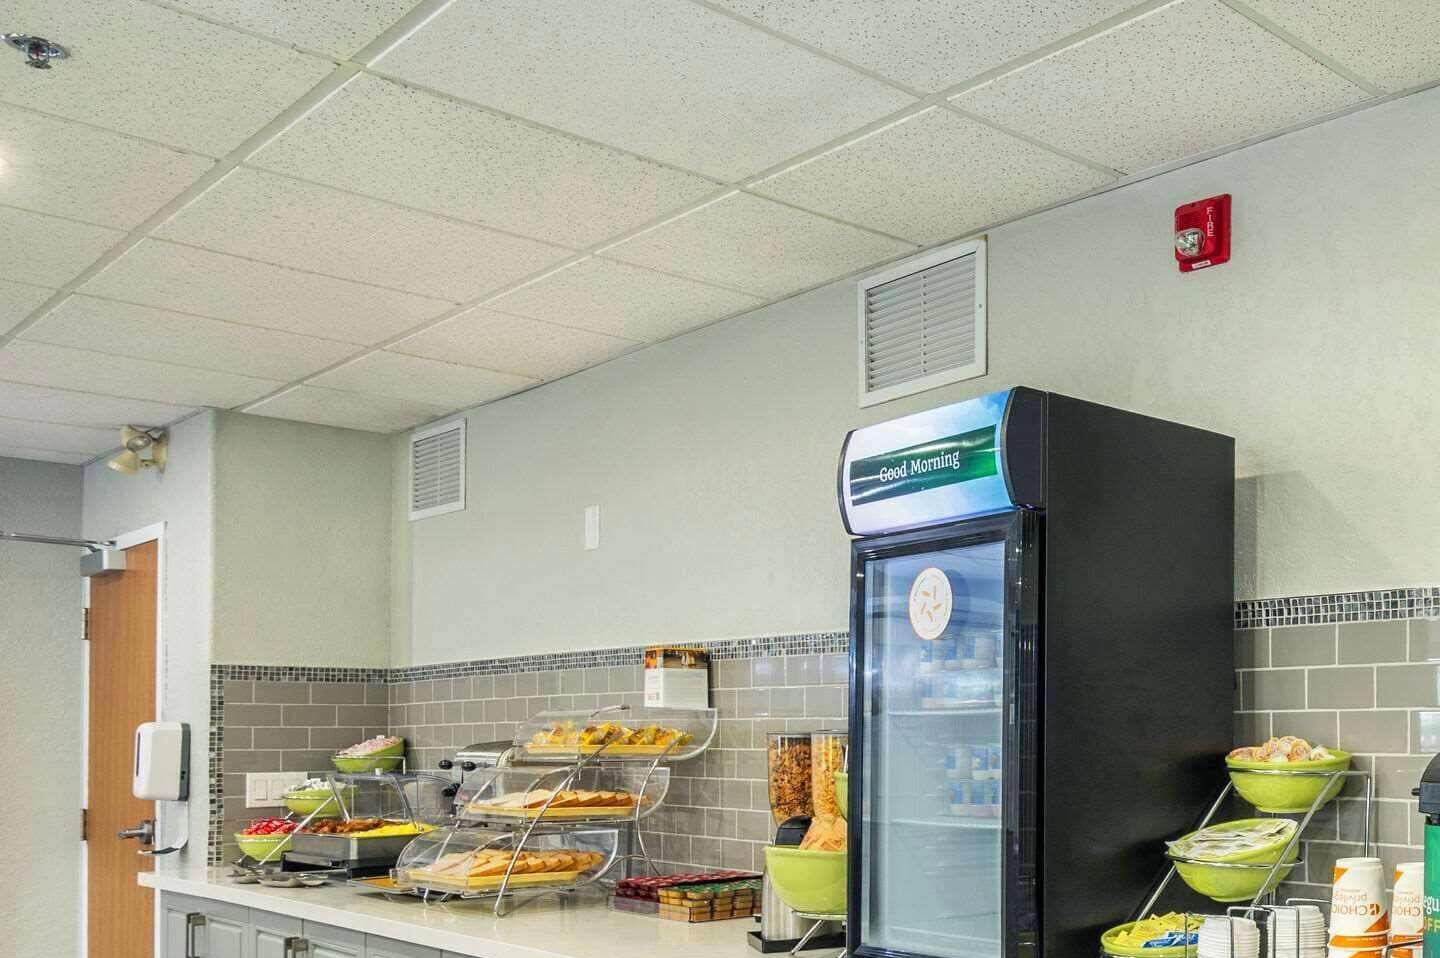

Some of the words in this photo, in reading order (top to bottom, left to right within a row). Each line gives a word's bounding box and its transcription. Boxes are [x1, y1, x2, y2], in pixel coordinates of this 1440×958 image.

[879, 464, 907, 482] Good
[910, 450, 960, 476] Morning
[1331, 903, 1368, 916] CHOIC
